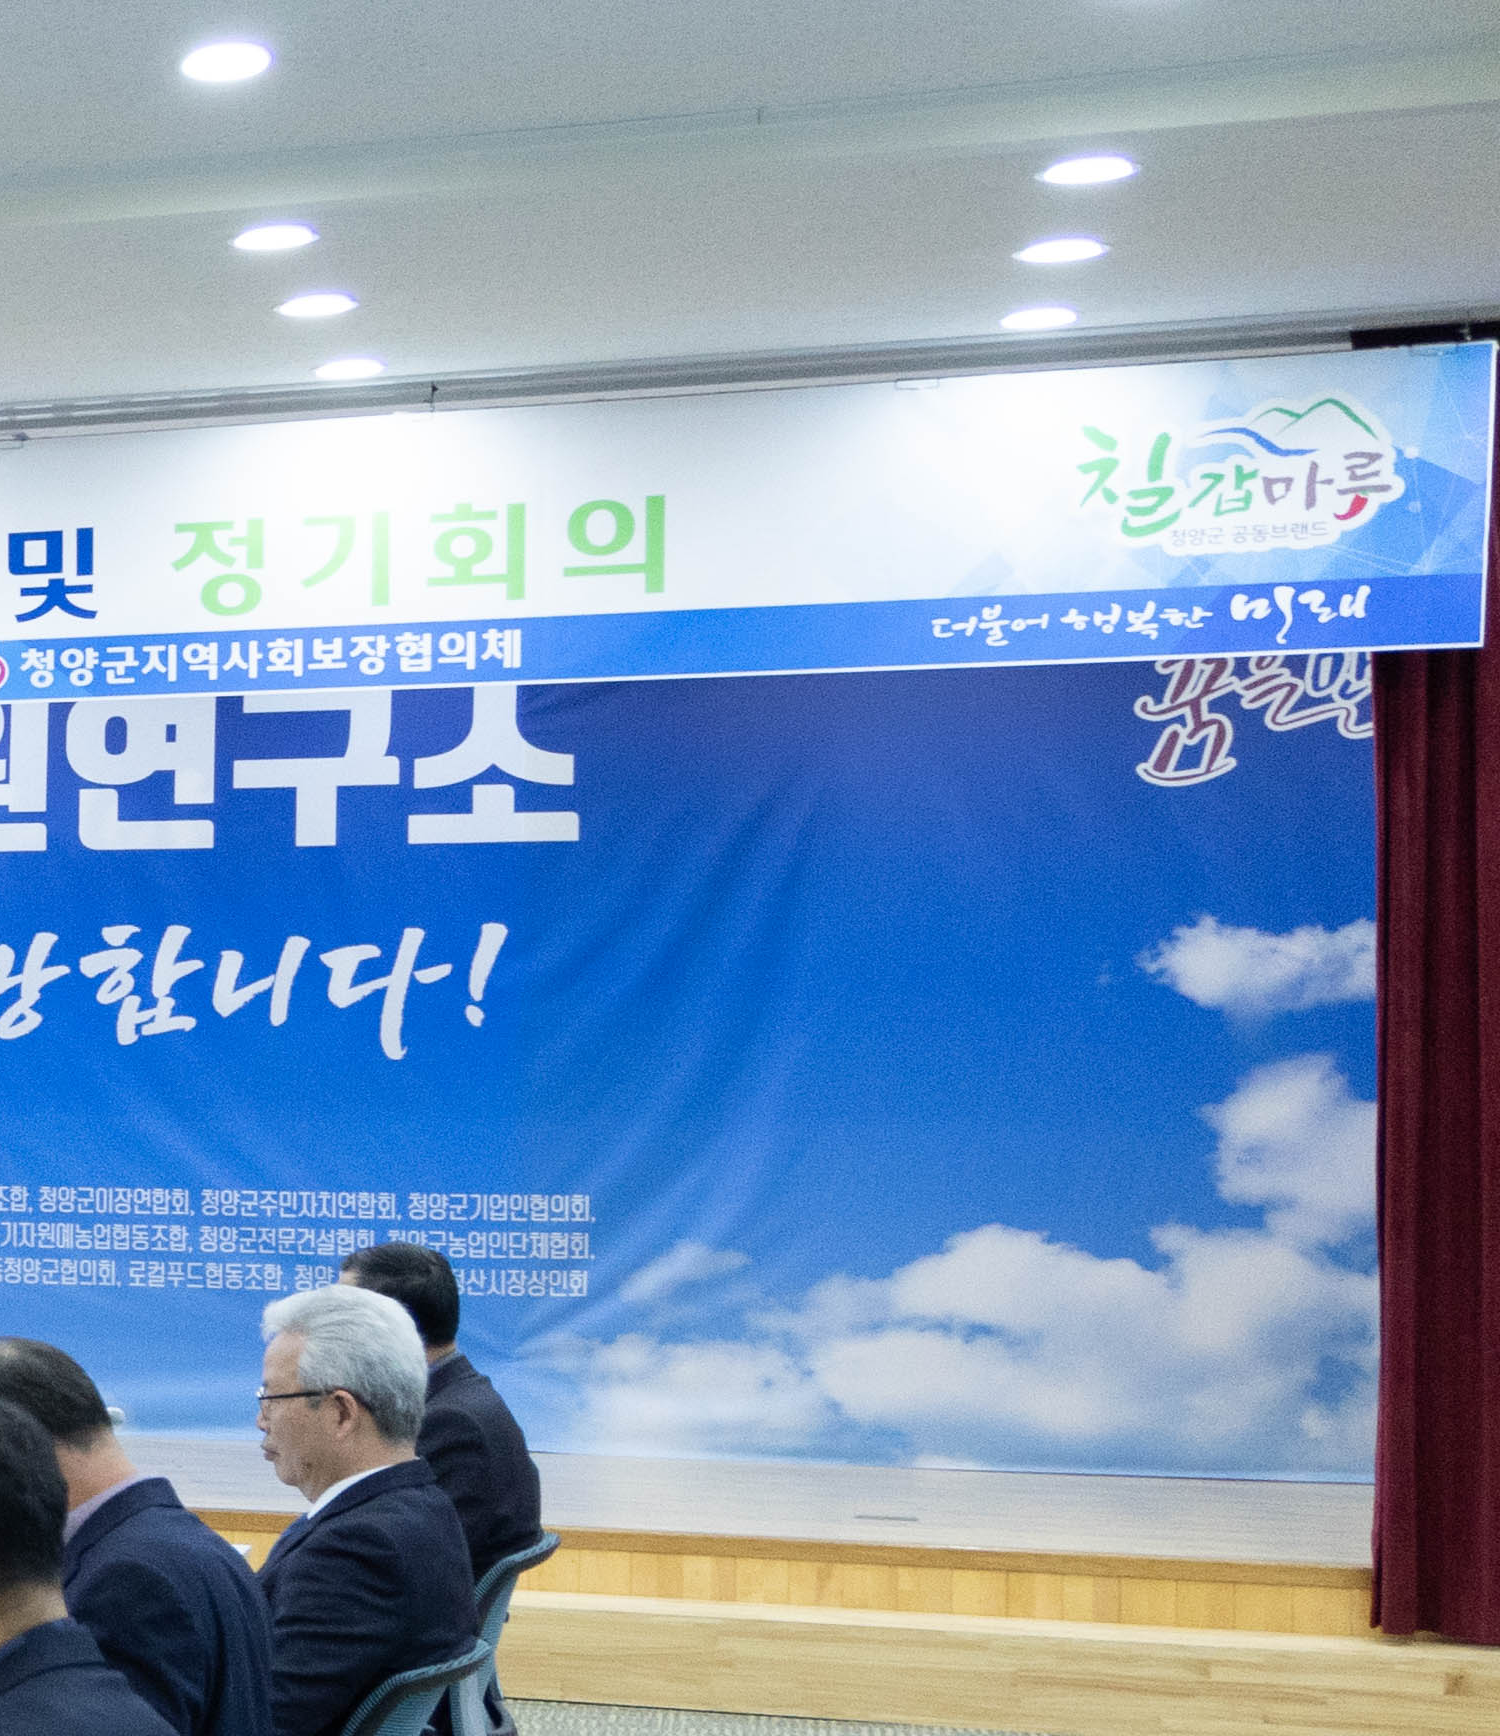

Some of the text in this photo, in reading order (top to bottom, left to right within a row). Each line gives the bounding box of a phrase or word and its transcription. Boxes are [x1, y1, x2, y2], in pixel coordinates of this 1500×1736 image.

[1076, 425, 1392, 538] 칠갑마루
[6, 526, 100, 624] 및
[170, 493, 668, 617] 정기회의
[1232, 520, 1329, 543] 공동브랜드
[931, 585, 1371, 646] 더불어 행복한 미래
[21, 627, 524, 688] 청양군지역사회보장협의체
[39, 1185, 195, 1217] 청양군이장연합회,
[201, 1188, 401, 1221] 청양군주민자치연합회,
[408, 1191, 596, 1223] 청양군기업인협의회,
[128, 1259, 288, 1292] 로컬푸드협동조합,
